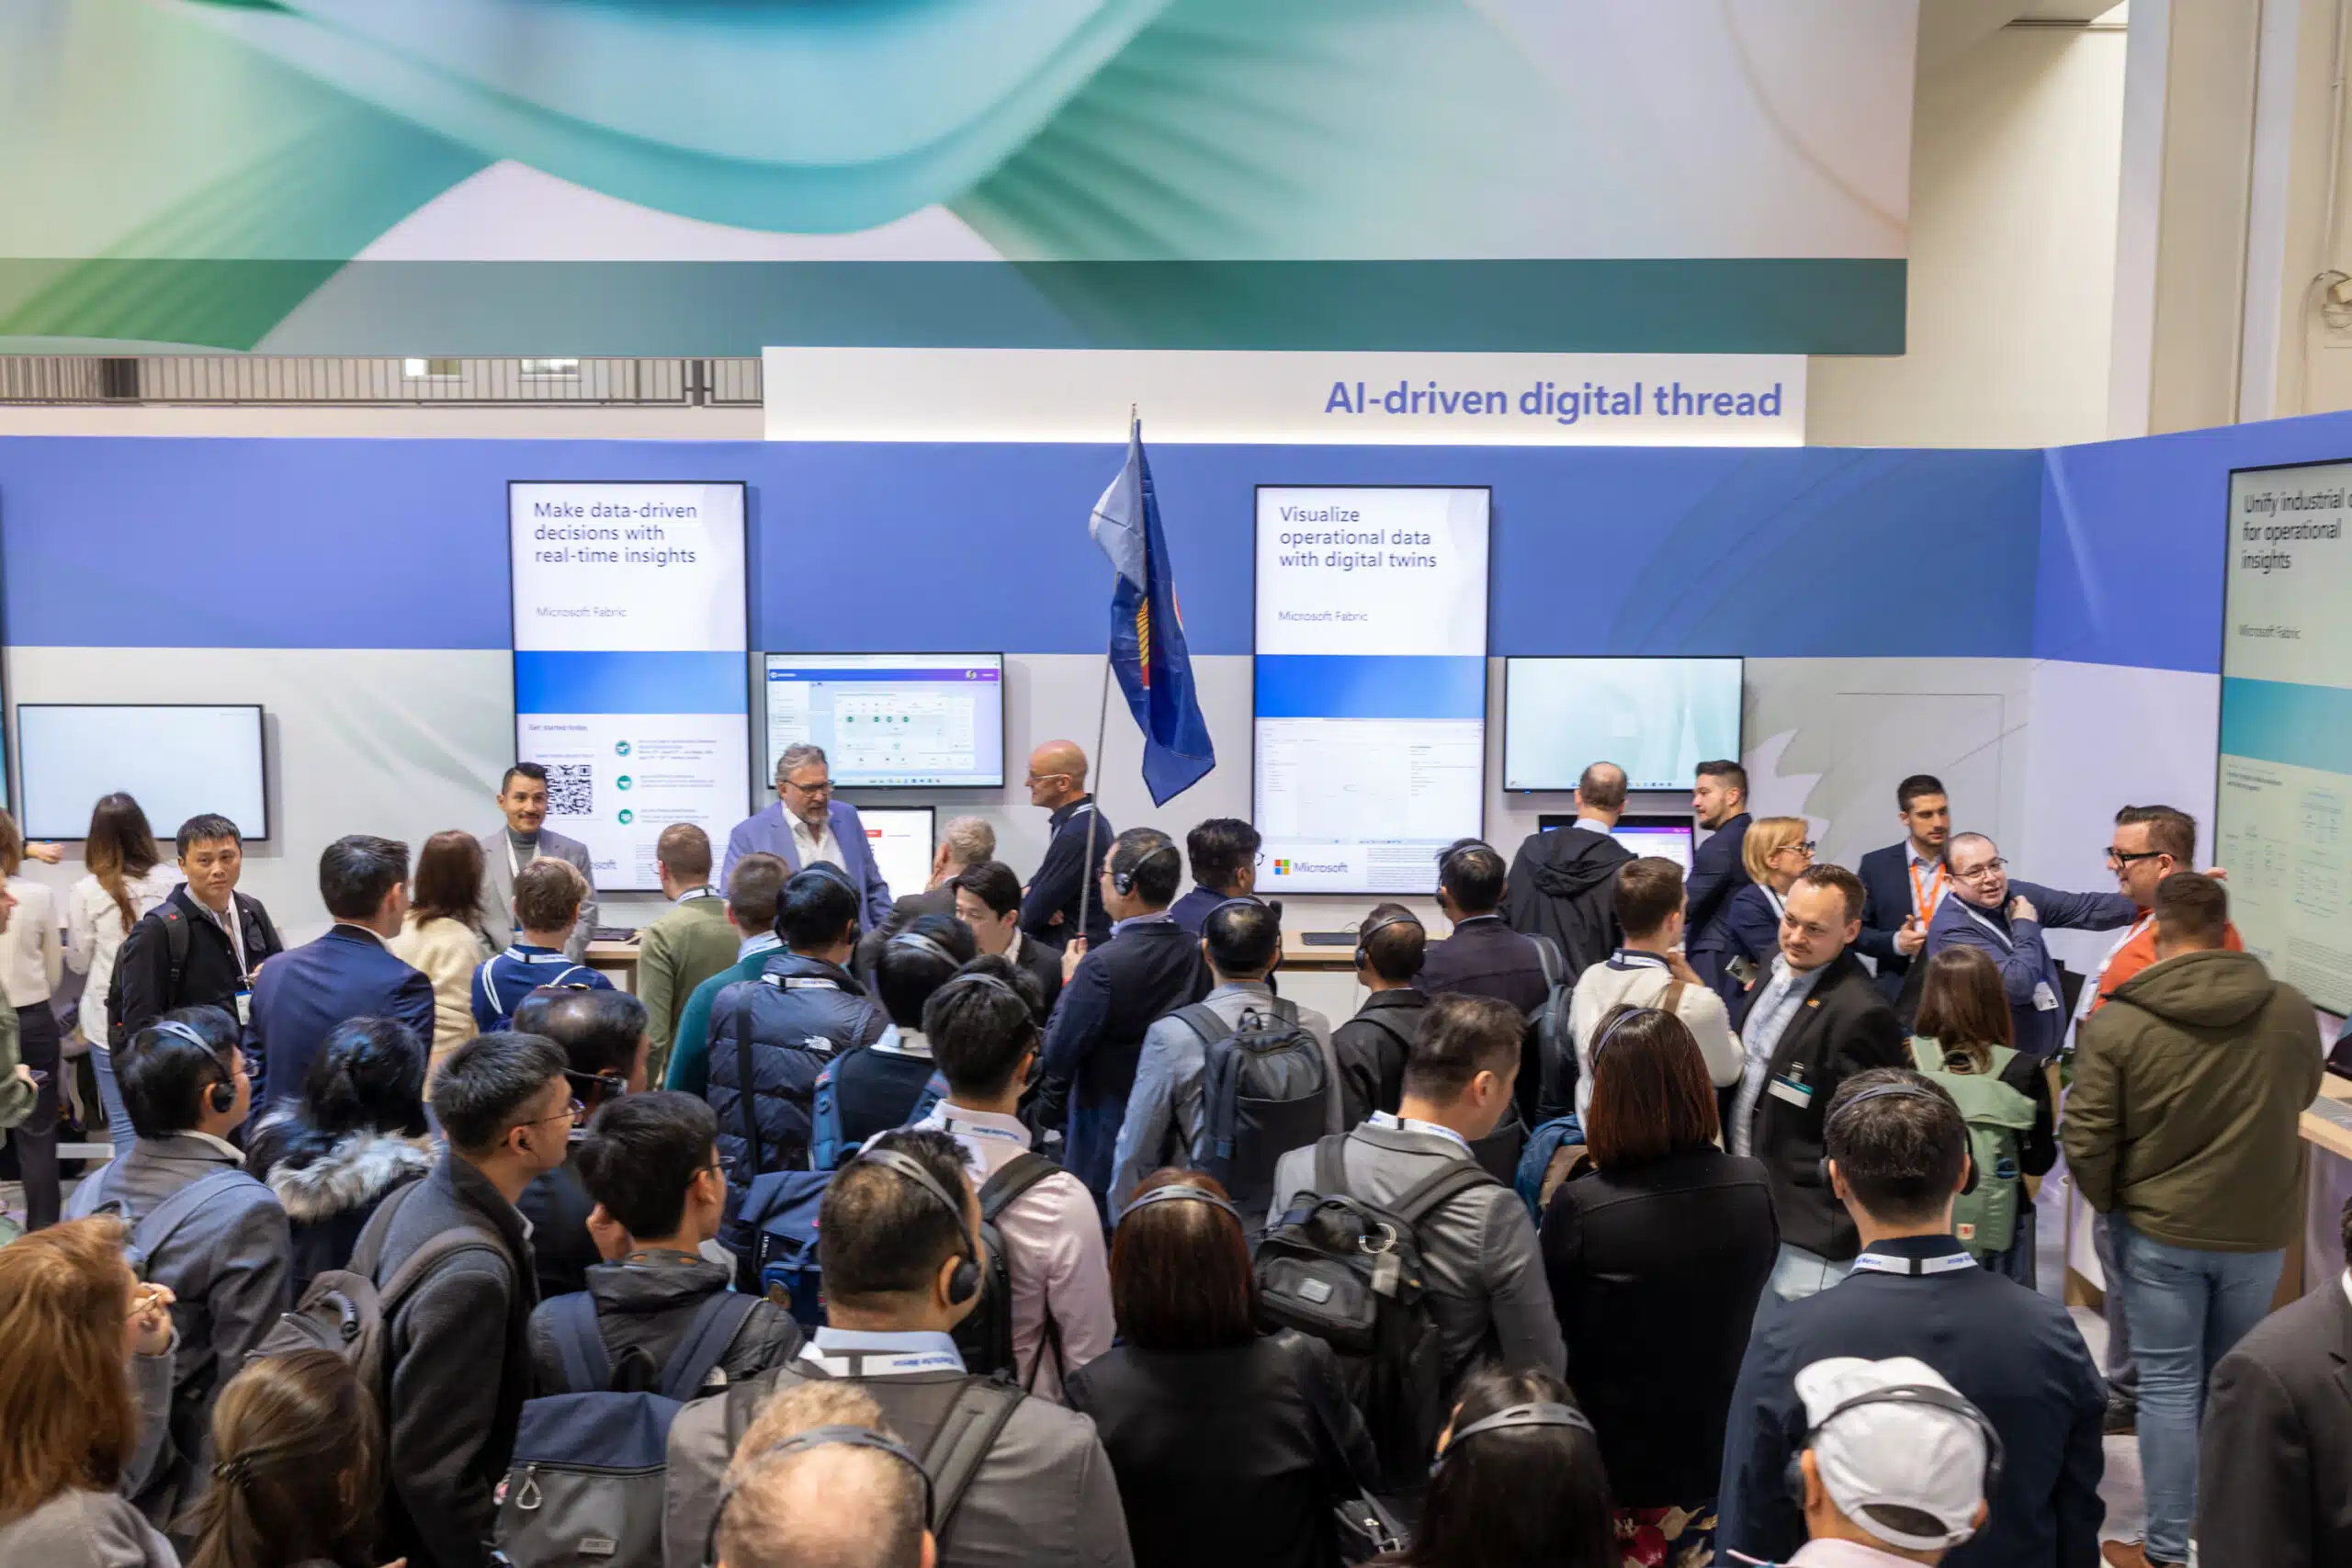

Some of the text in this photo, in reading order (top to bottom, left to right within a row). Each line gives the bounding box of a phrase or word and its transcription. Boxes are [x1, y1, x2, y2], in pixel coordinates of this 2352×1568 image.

[1324, 380, 1782, 424] AI-driven digital thread
[535, 502, 697, 518] Make data-driven
[2244, 491, 2278, 518] Unify
[2280, 488, 2345, 513] industrial
[1280, 506, 1360, 522] Visualize
[535, 525, 665, 540] decisions with
[1280, 528, 1431, 548] operational data
[2243, 518, 2342, 547] for operational
[535, 547, 696, 568] real-time insights
[1279, 551, 1438, 572] with digital twins
[2241, 549, 2291, 575] insights
[536, 606, 628, 617] Microsoft Fabric
[1278, 610, 1368, 622] Microsoft Fabric
[1294, 862, 1349, 874] Microsoft
